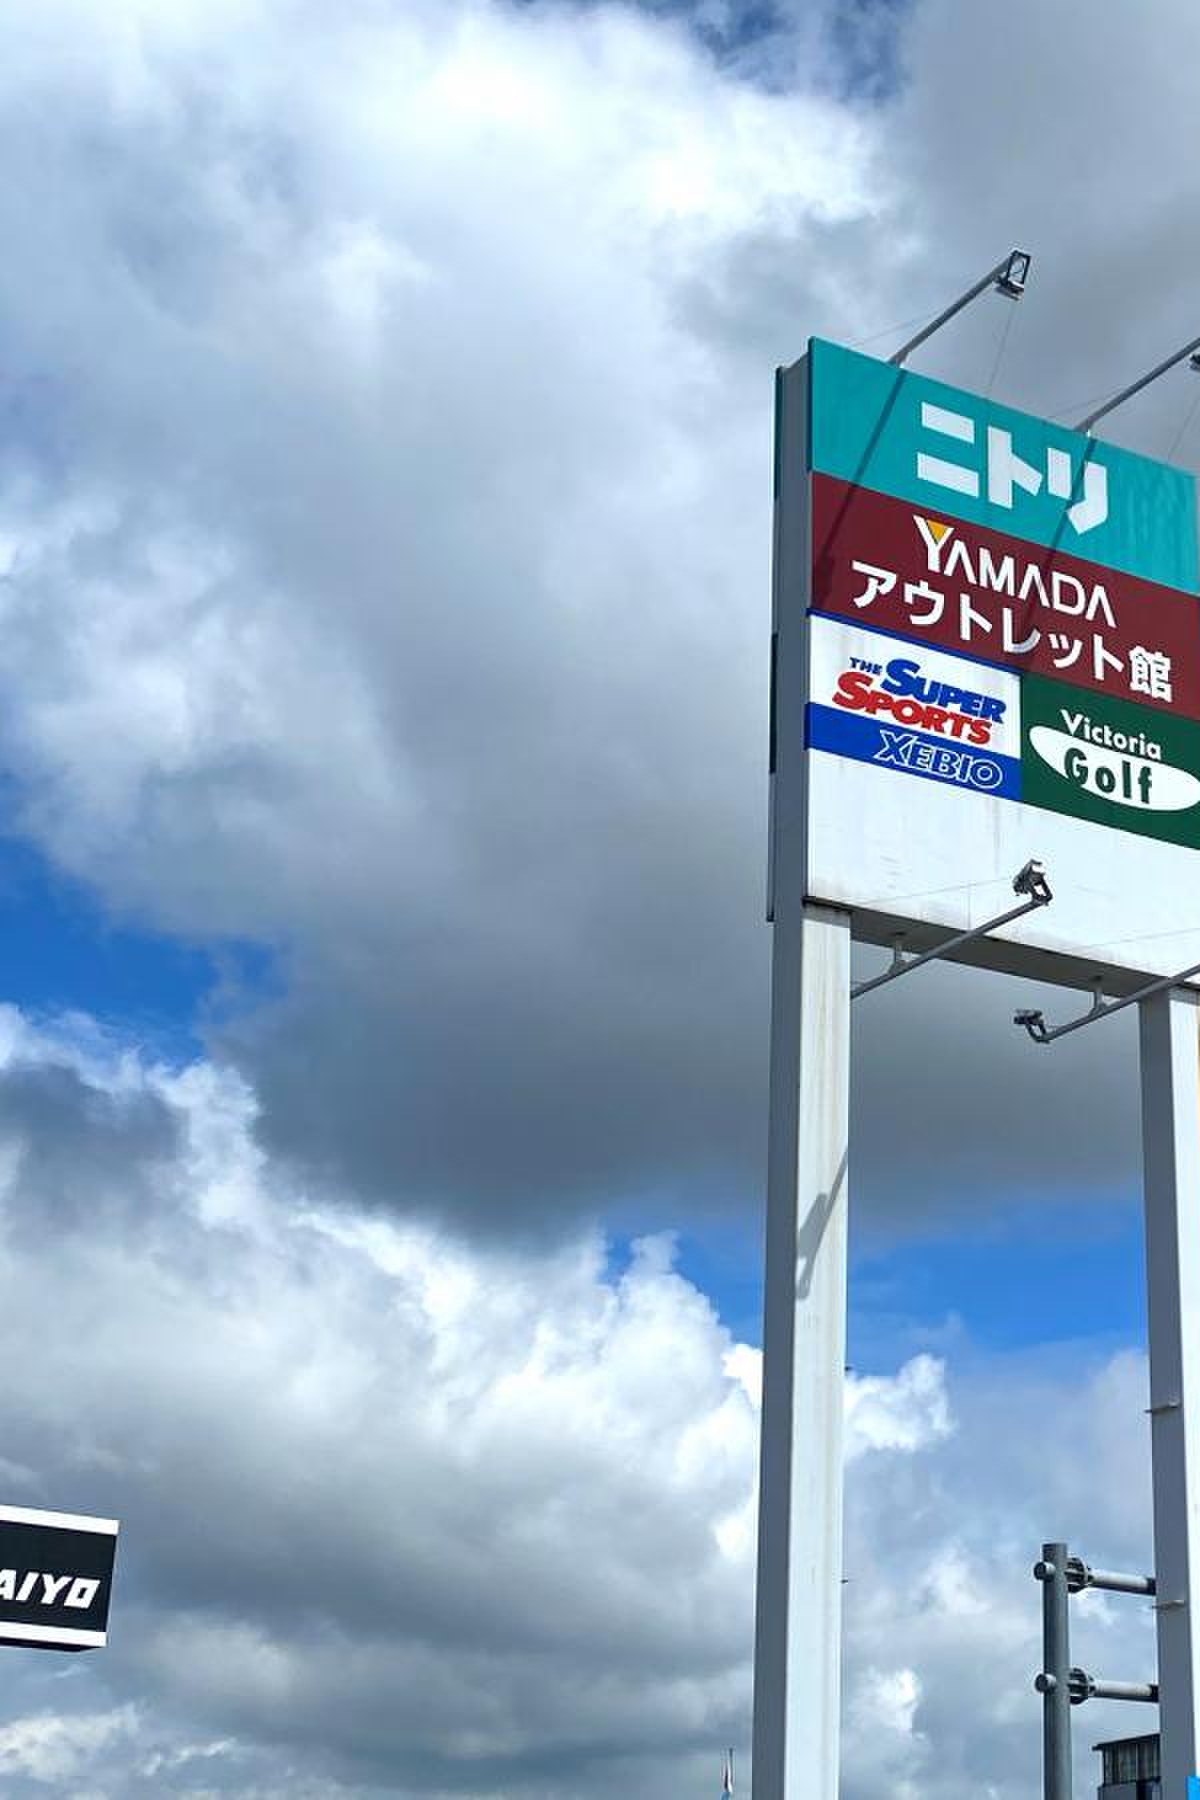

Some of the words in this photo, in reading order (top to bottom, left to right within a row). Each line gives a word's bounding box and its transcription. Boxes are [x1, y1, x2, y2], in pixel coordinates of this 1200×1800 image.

[916, 402, 1108, 534] ニトリ
[913, 514, 1117, 628] YAMADA
[852, 560, 1172, 702] アウトレット館
[832, 671, 992, 745] SPORTS
[849, 657, 882, 675] THE
[880, 658, 1006, 724] SUPER
[873, 730, 1003, 788] XEBIO
[1060, 708, 1162, 760] Victoria
[1064, 747, 1152, 804] Golf
